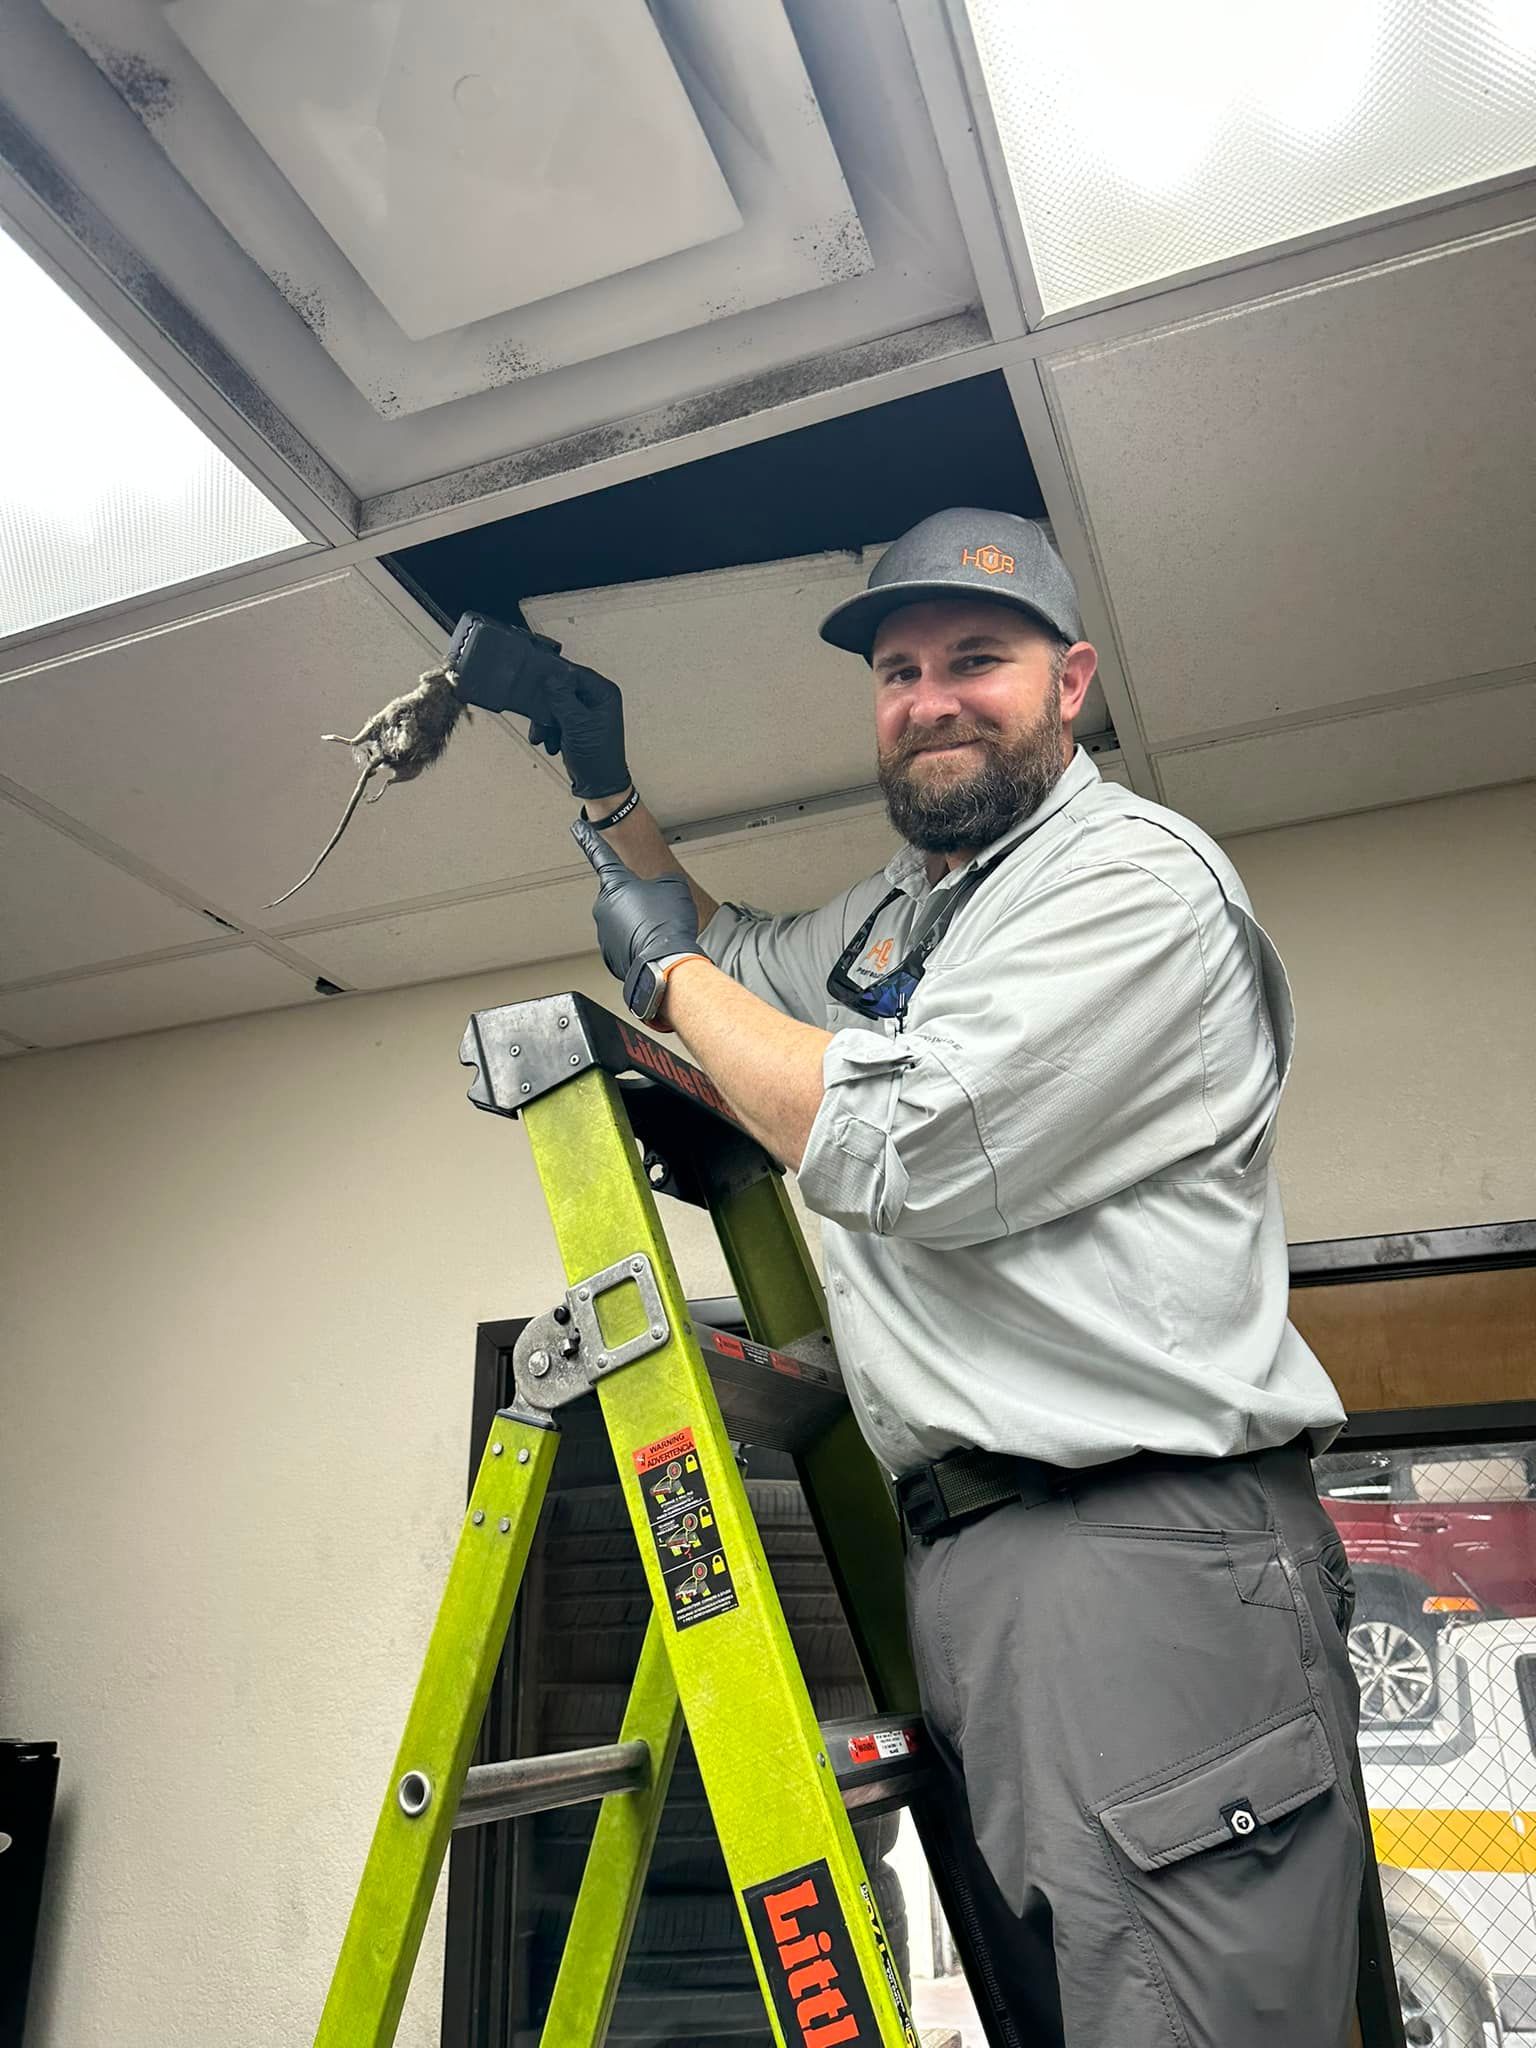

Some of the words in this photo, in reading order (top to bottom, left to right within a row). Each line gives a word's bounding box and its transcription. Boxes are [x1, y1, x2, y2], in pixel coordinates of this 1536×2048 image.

[961, 544, 1016, 575] HUB
[617, 802, 633, 818] TAKE
[647, 1441, 695, 1468] ADVERTENCIA
[649, 1432, 685, 1453] WARNING
